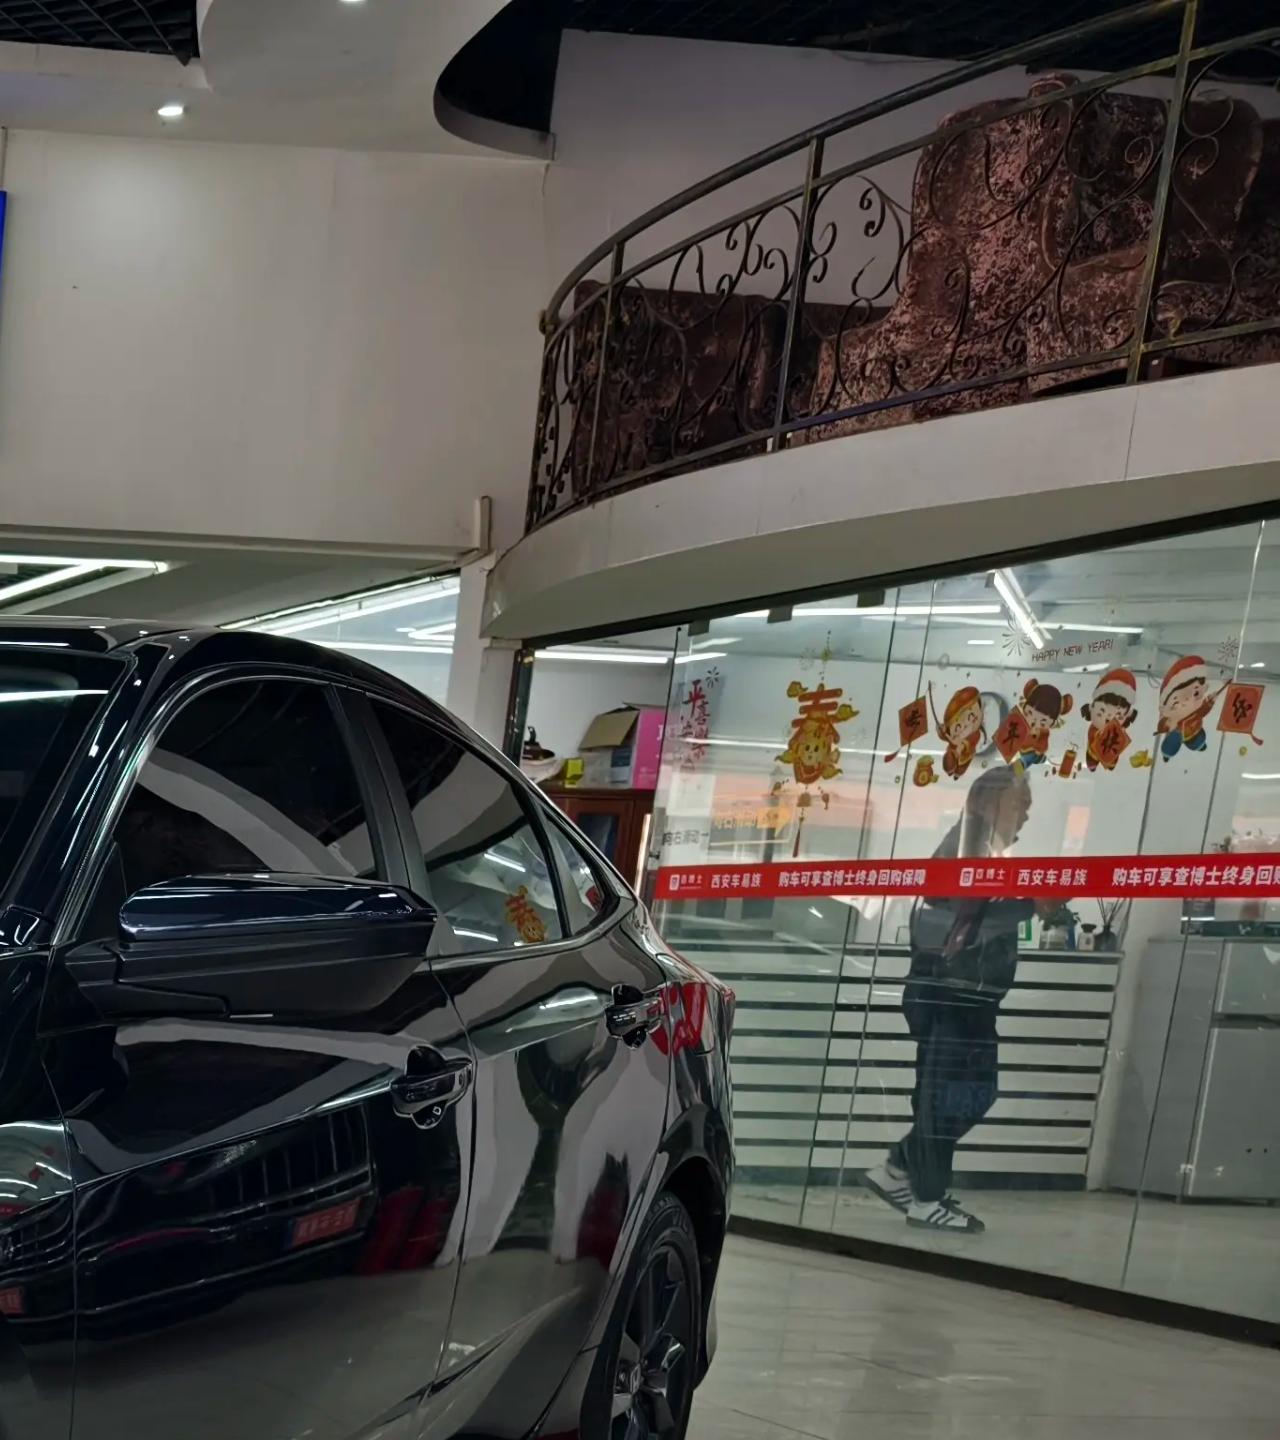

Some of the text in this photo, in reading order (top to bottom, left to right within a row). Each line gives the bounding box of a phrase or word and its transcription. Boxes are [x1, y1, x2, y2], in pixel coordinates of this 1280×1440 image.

[1031, 648, 1060, 662] HAPPY
[1063, 644, 1083, 657] NEW
[710, 872, 762, 889] 西安车易族
[778, 868, 927, 888] 购车可享查博士终身回购保障
[1016, 868, 1088, 886] 西安车易族
